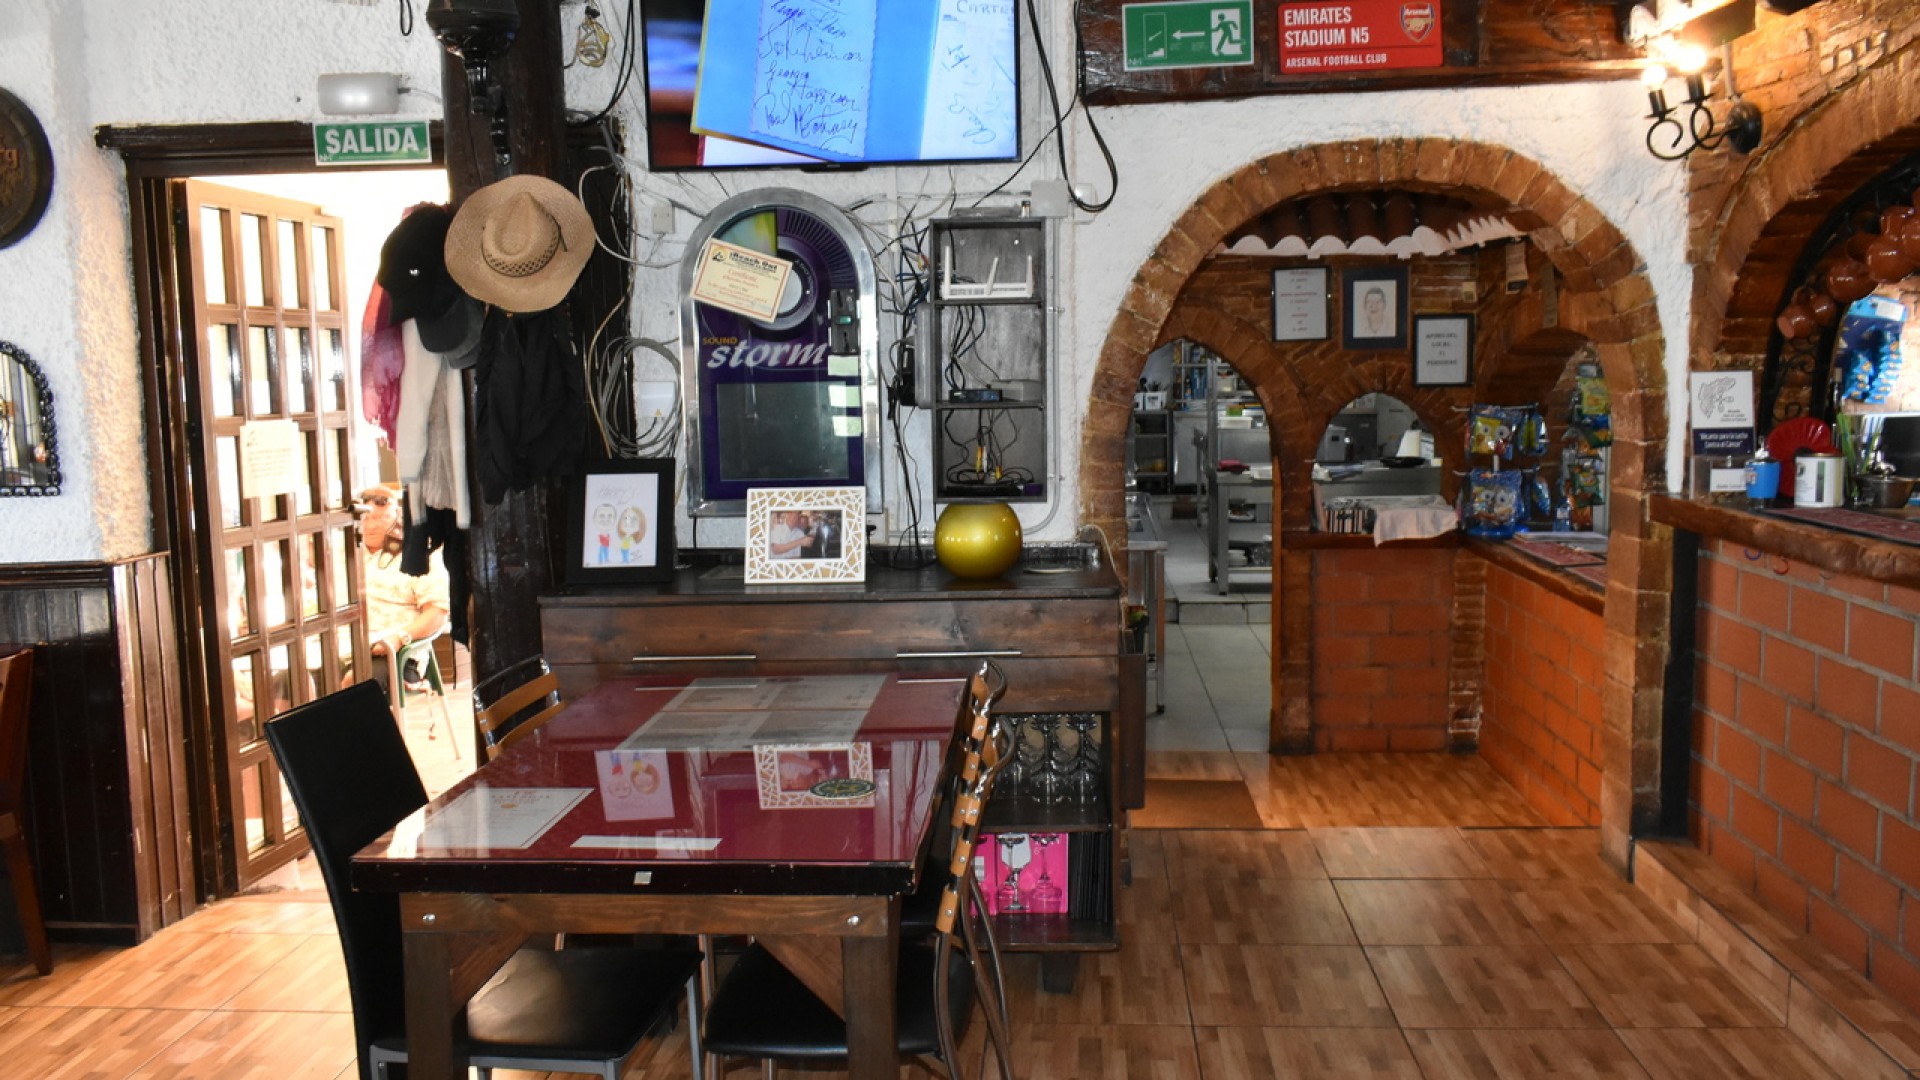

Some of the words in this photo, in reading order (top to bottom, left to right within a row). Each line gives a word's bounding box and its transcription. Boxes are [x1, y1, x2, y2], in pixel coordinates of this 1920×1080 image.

[1284, 6, 1353, 26] EMIRATES
[1404, 8, 1431, 16] Arsenal
[1285, 28, 1346, 48] STADIUM
[1351, 26, 1370, 45] N5
[1286, 57, 1322, 68] ARSENAL
[1323, 54, 1363, 66] FOOTBALL
[1365, 53, 1388, 64] CLUB
[325, 127, 419, 154] SALIDA
[702, 336, 739, 346] SOUND
[706, 338, 829, 369] storm
